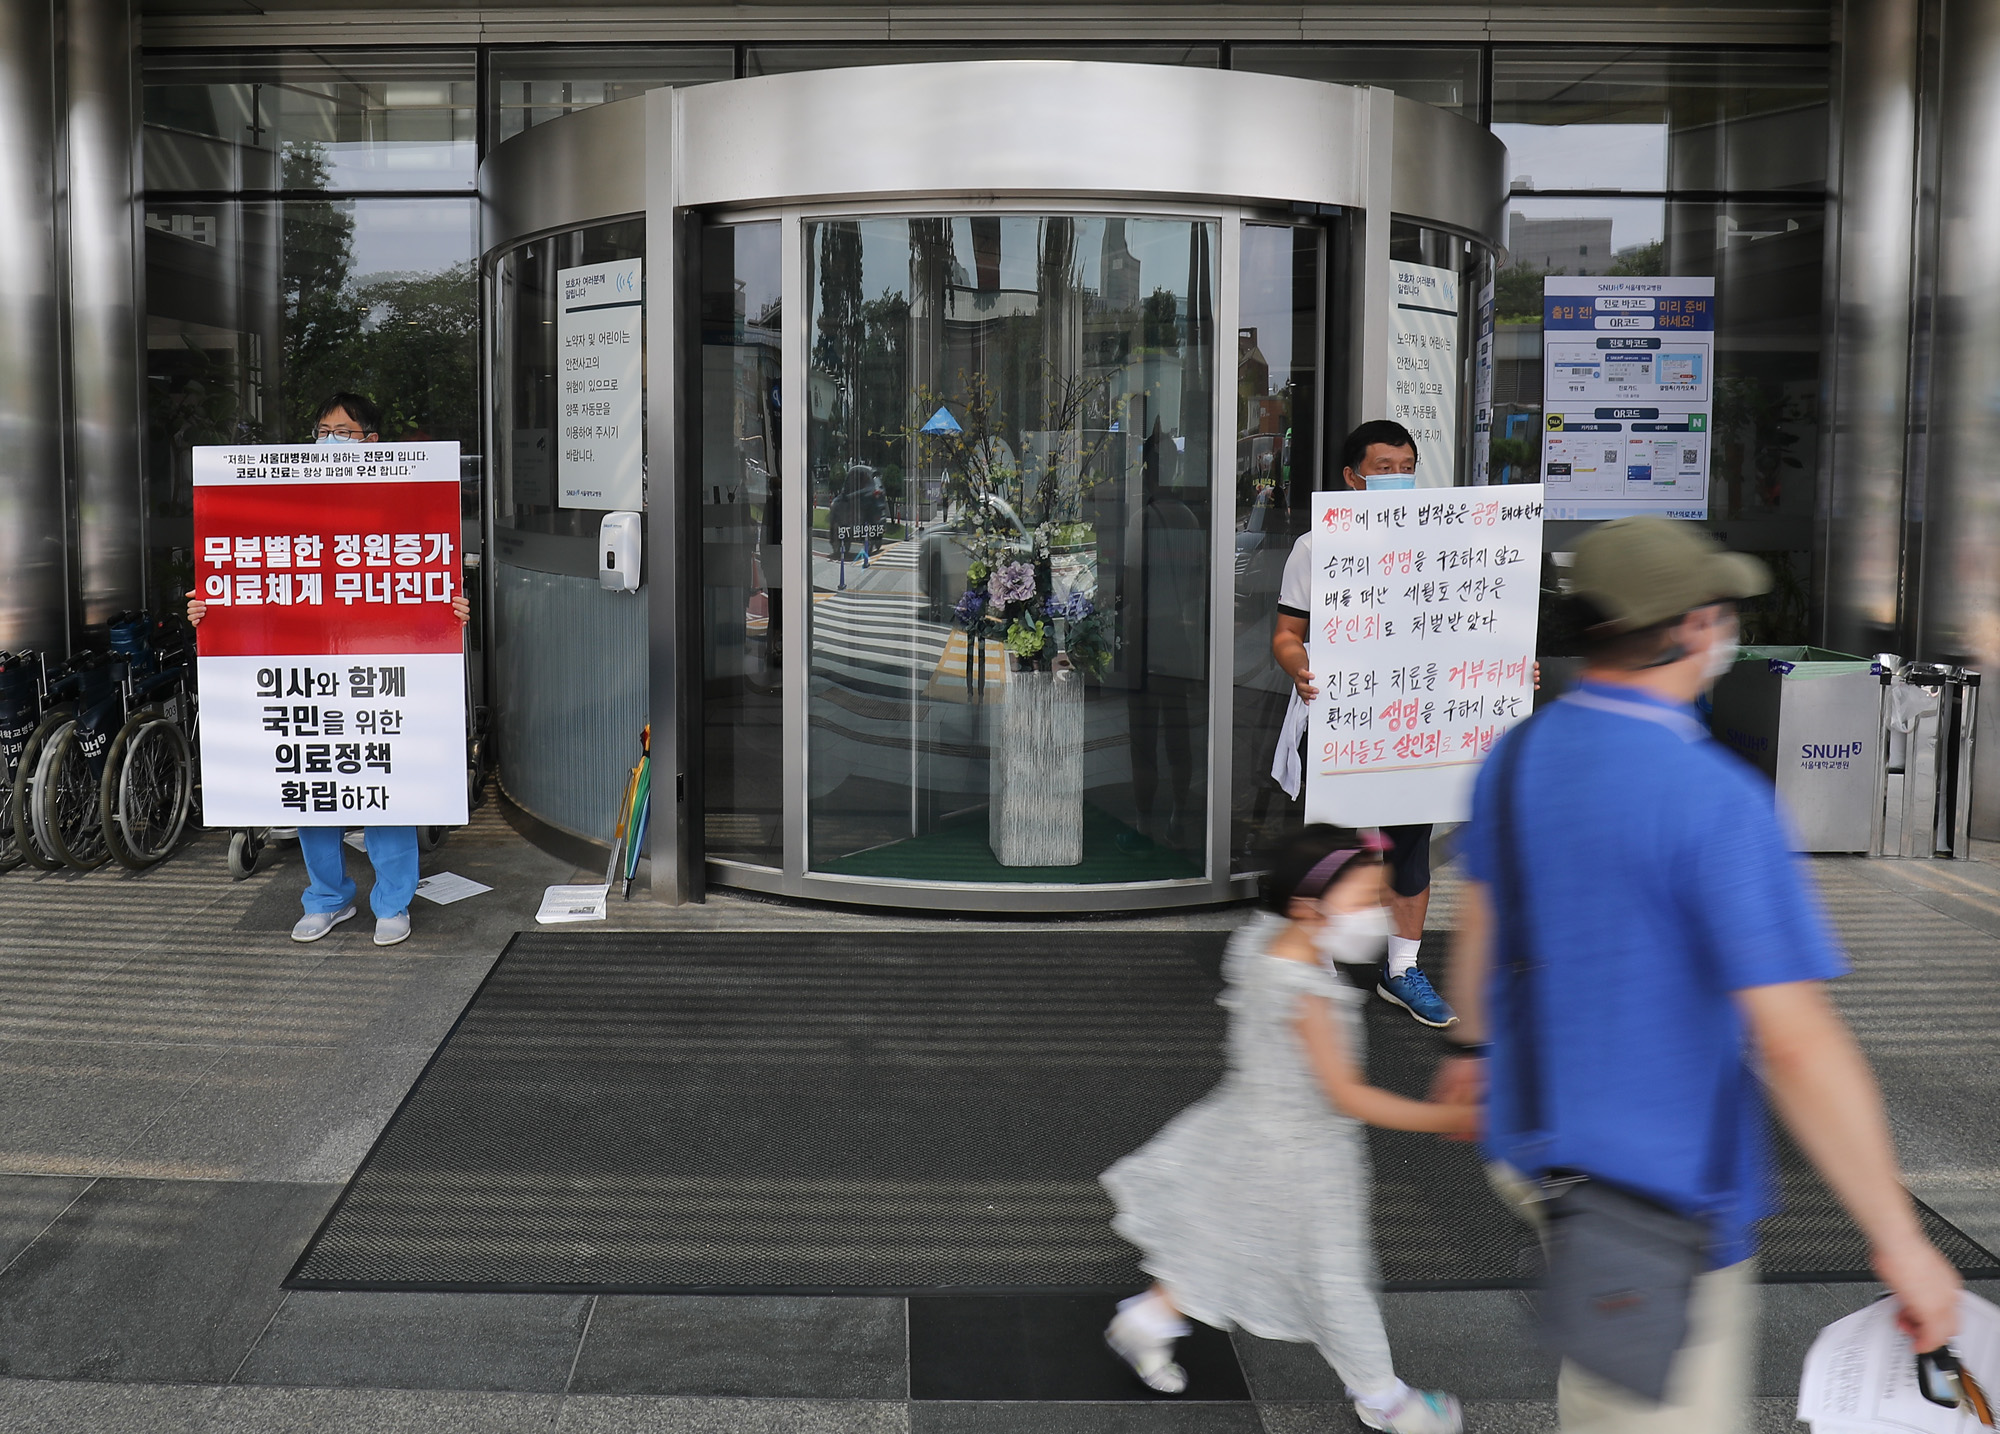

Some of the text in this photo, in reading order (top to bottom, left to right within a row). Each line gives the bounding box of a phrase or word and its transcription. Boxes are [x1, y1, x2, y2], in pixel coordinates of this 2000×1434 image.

[565, 274, 606, 290] 보호자 여러분께
[1398, 273, 1436, 288] 보호자 여러분께
[1625, 284, 1662, 292] 서울대학교병원
[565, 288, 586, 300] 알립니다
[1397, 284, 1420, 296] 알립니다
[1603, 299, 1647, 309] 진료 바코드
[1659, 300, 1706, 313] 미리 준비
[1552, 306, 1593, 319] 출입 전!
[1610, 318, 1640, 328] QR코드
[1659, 315, 1695, 328] 하세요!
[565, 330, 630, 348] 노약자 및 어린이는
[1396, 333, 1451, 351] 노약자 및 어린이는
[1609, 339, 1648, 348] 진료 바코드
[565, 356, 600, 372] 안전사고의
[1396, 356, 1430, 372] 안전사고의
[565, 378, 619, 394] 위험이 있으므로
[1396, 380, 1443, 396] 위험이 있으므로
[565, 401, 611, 417] 양쪽 자동문을
[1395, 404, 1437, 420] 양쪽 자동문을
[1613, 409, 1641, 418] QR코드
[1692, 418, 1702, 428] N
[565, 425, 619, 440] 이용하여 주시기
[1424, 428, 1442, 442] 주시기
[259, 452, 329, 464] 서울대병원에서
[332, 452, 360, 463] 일하는
[363, 451, 394, 463] 전문의
[398, 450, 429, 462] 입니다.
[565, 449, 595, 463] 바랍니다.
[236, 467, 267, 479] 코로나
[270, 467, 300, 479] 진료는
[303, 466, 322, 478] 항상
[325, 466, 353, 477] 파업에
[356, 465, 377, 477] 우선
[1377, 506, 1407, 528] 대한
[1418, 503, 1469, 526] 법적용은
[1666, 511, 1703, 519] 재난의료본부
[203, 534, 324, 569] 무분별한
[333, 532, 454, 567] 정원증가
[1324, 545, 1525, 579] 승객의 생명을 구조하지 않고
[204, 571, 455, 607] 의료체계 무너진다
[1324, 577, 1507, 611] 배를 떠난 세월호 선장은
[1322, 613, 1396, 644] 살인죄로
[256, 665, 406, 698] 의사와 함께
[1326, 655, 1527, 700] 진료와 치료를 거부하며
[164, 704, 177, 719] 203
[1326, 694, 1523, 732] 환자의 생명을 구하지 않는
[262, 705, 403, 737] 국민을 위한
[1321, 738, 1387, 768] 의사들도
[1392, 729, 1456, 760] 살인죄로
[1801, 744, 1850, 759] SNUH
[275, 742, 392, 774] 의료정책
[1800, 761, 1849, 770] 서울대학교병원
[281, 780, 389, 812] 확립하자
